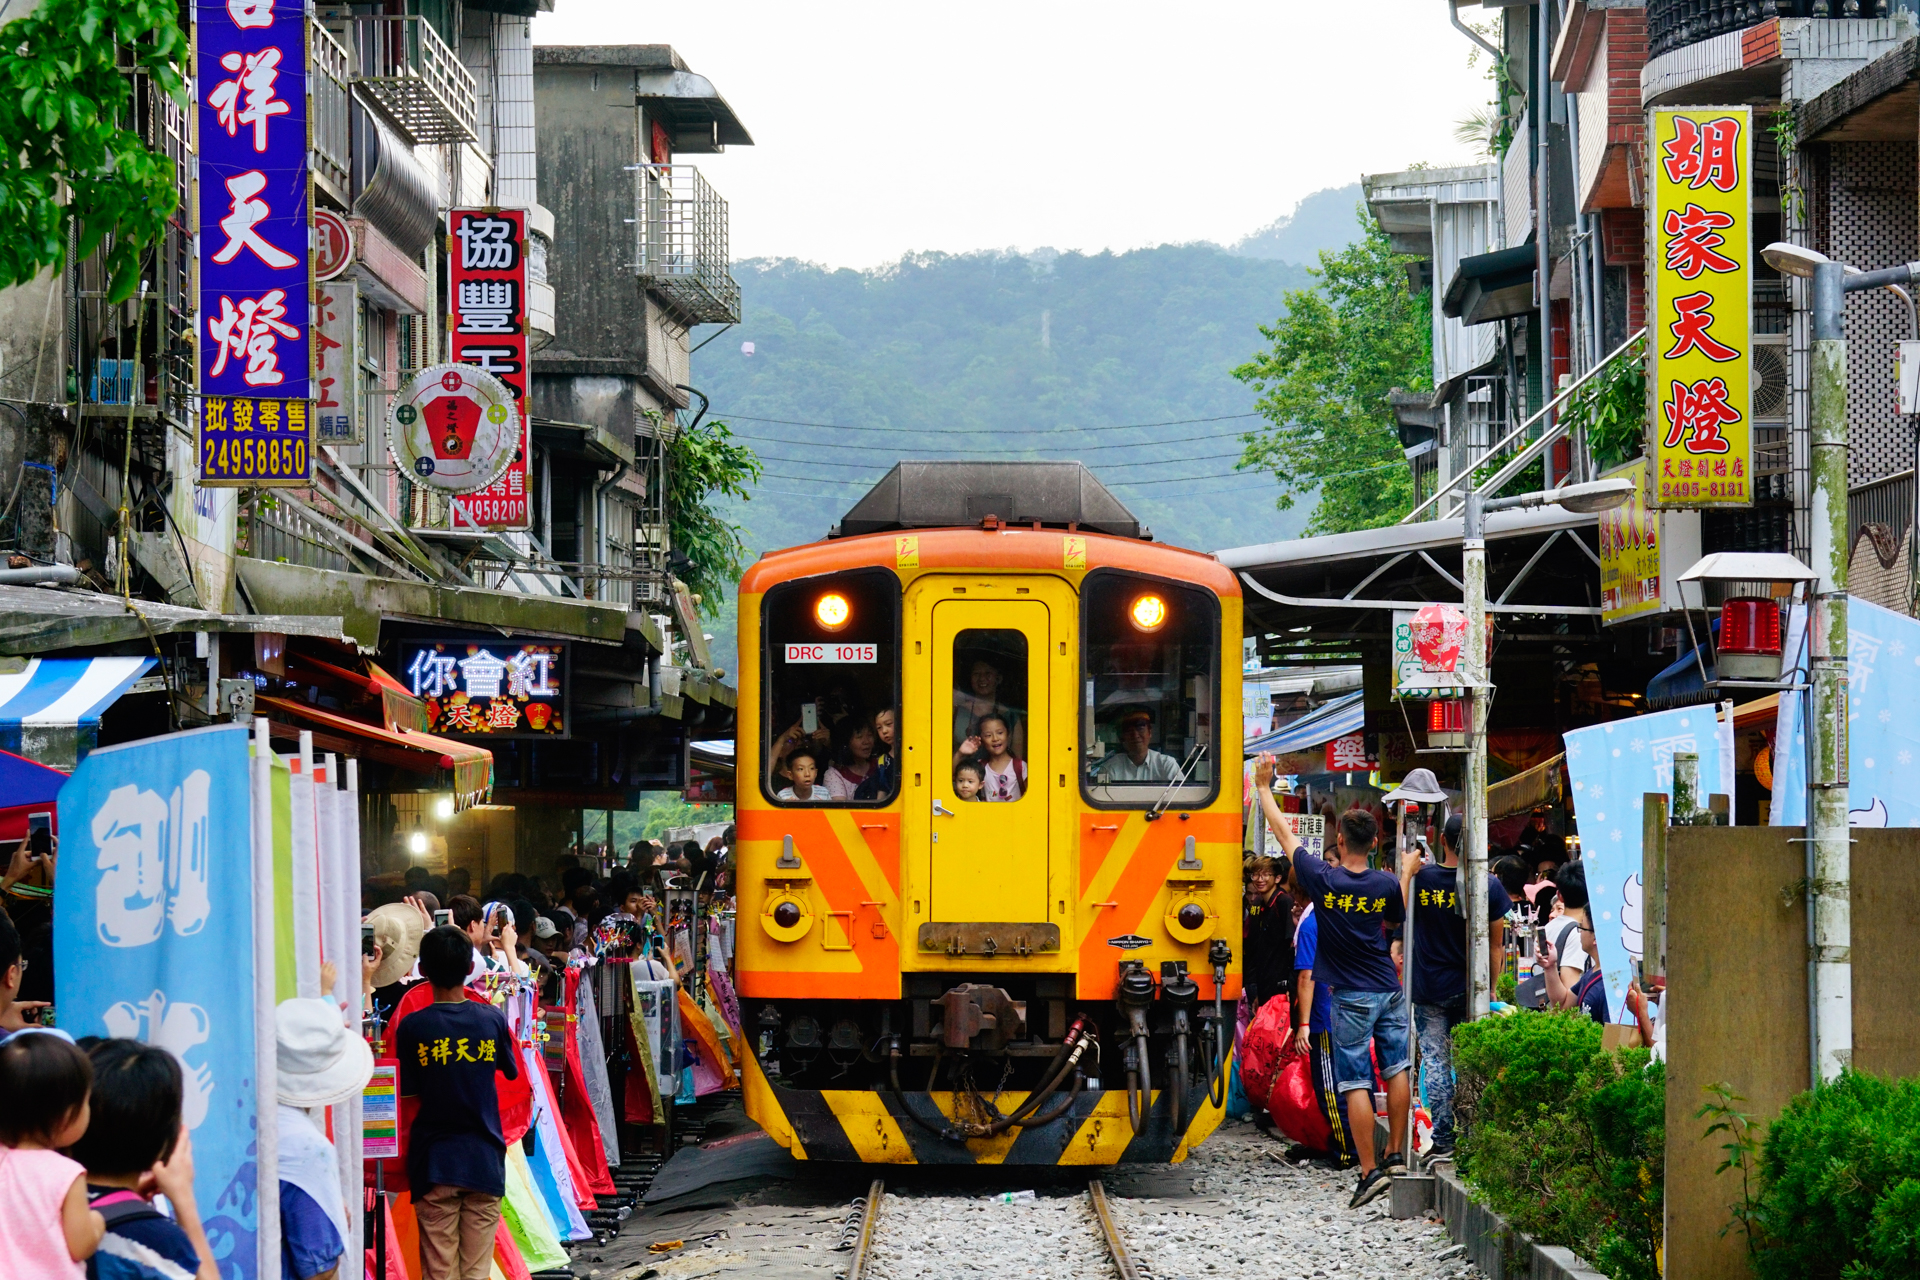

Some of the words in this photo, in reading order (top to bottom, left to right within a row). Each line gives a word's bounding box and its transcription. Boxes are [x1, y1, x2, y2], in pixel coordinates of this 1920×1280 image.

[1662, 115, 1742, 454] 胡家天燈
[205, 397, 306, 432] 批發零售
[205, 438, 306, 475] 24958850
[1662, 457, 1744, 478] 天燈創始店
[1662, 482, 1744, 497] 2495-8131
[788, 646, 824, 660] DRC
[835, 646, 874, 660] 1015
[408, 648, 559, 698] 你會紅
[447, 704, 519, 728] 天燈
[1333, 734, 1379, 769] 藥
[1323, 892, 1387, 914] 吉祥天燈
[417, 1037, 496, 1067] 吉祥天燈
